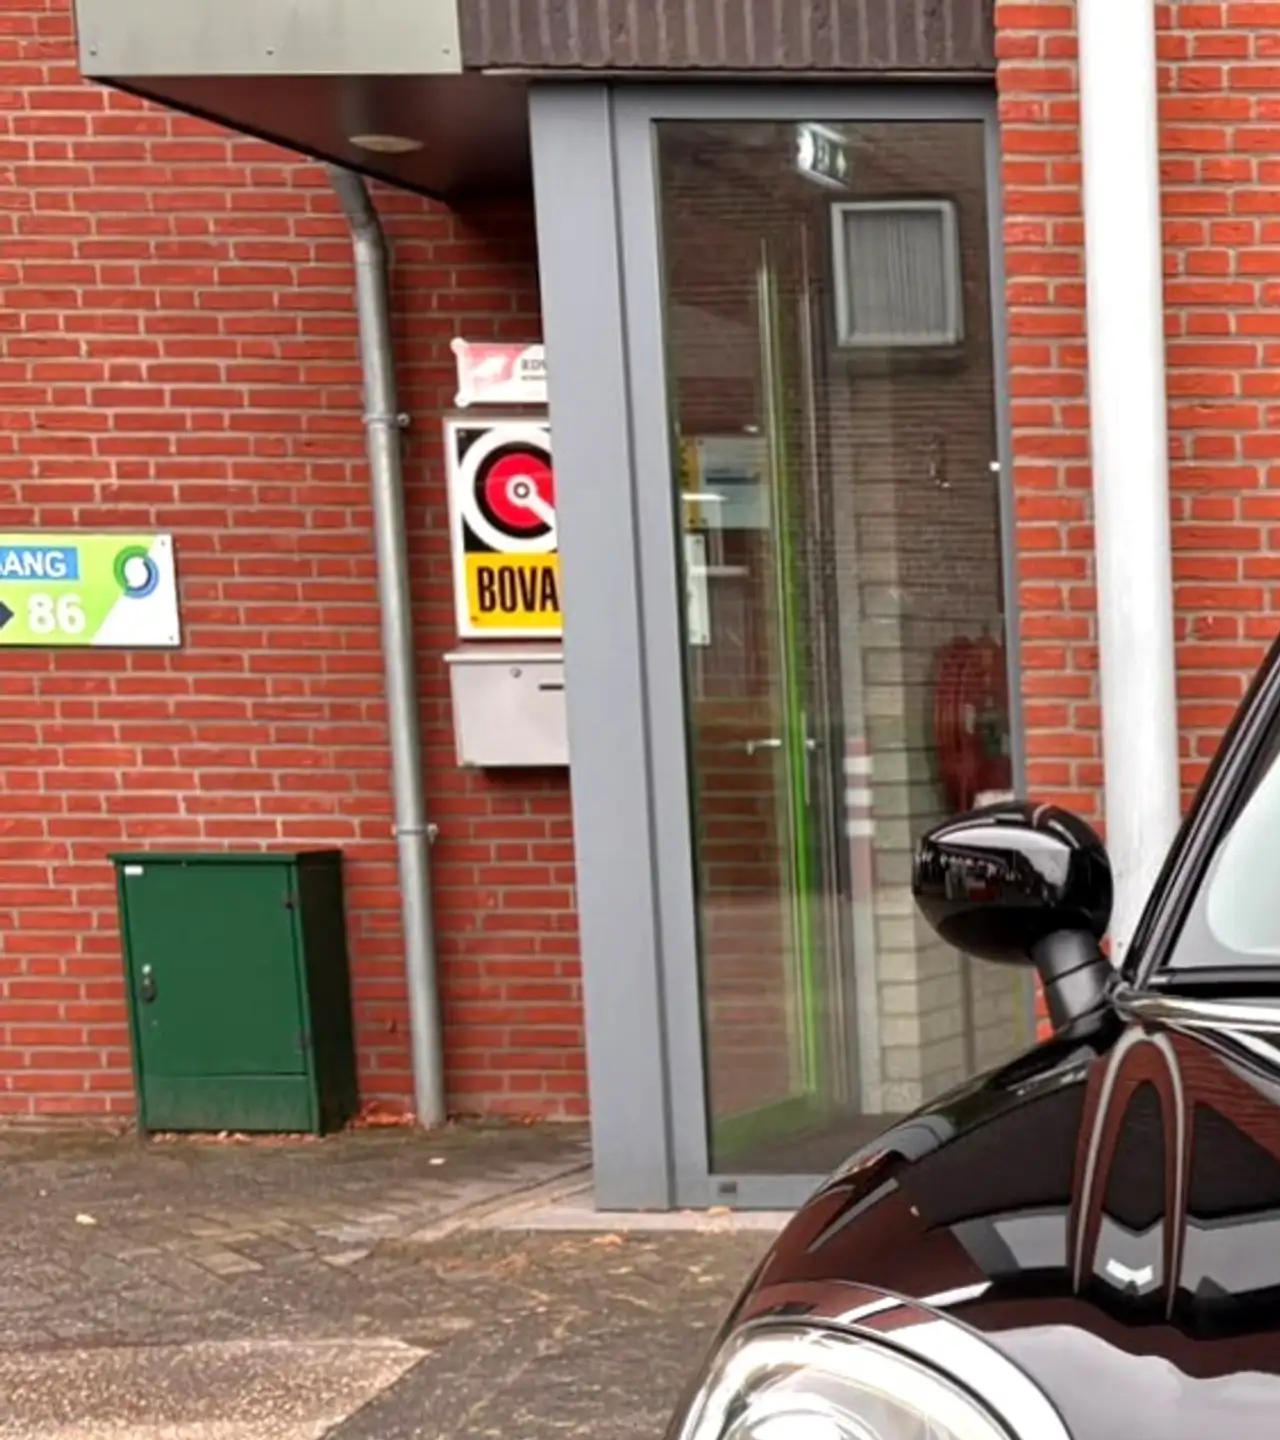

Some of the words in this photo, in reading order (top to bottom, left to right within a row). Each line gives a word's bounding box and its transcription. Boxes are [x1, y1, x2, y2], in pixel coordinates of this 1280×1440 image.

[0, 550, 67, 577] ANG
[477, 565, 560, 613] BOVA
[28, 593, 86, 634] 86
